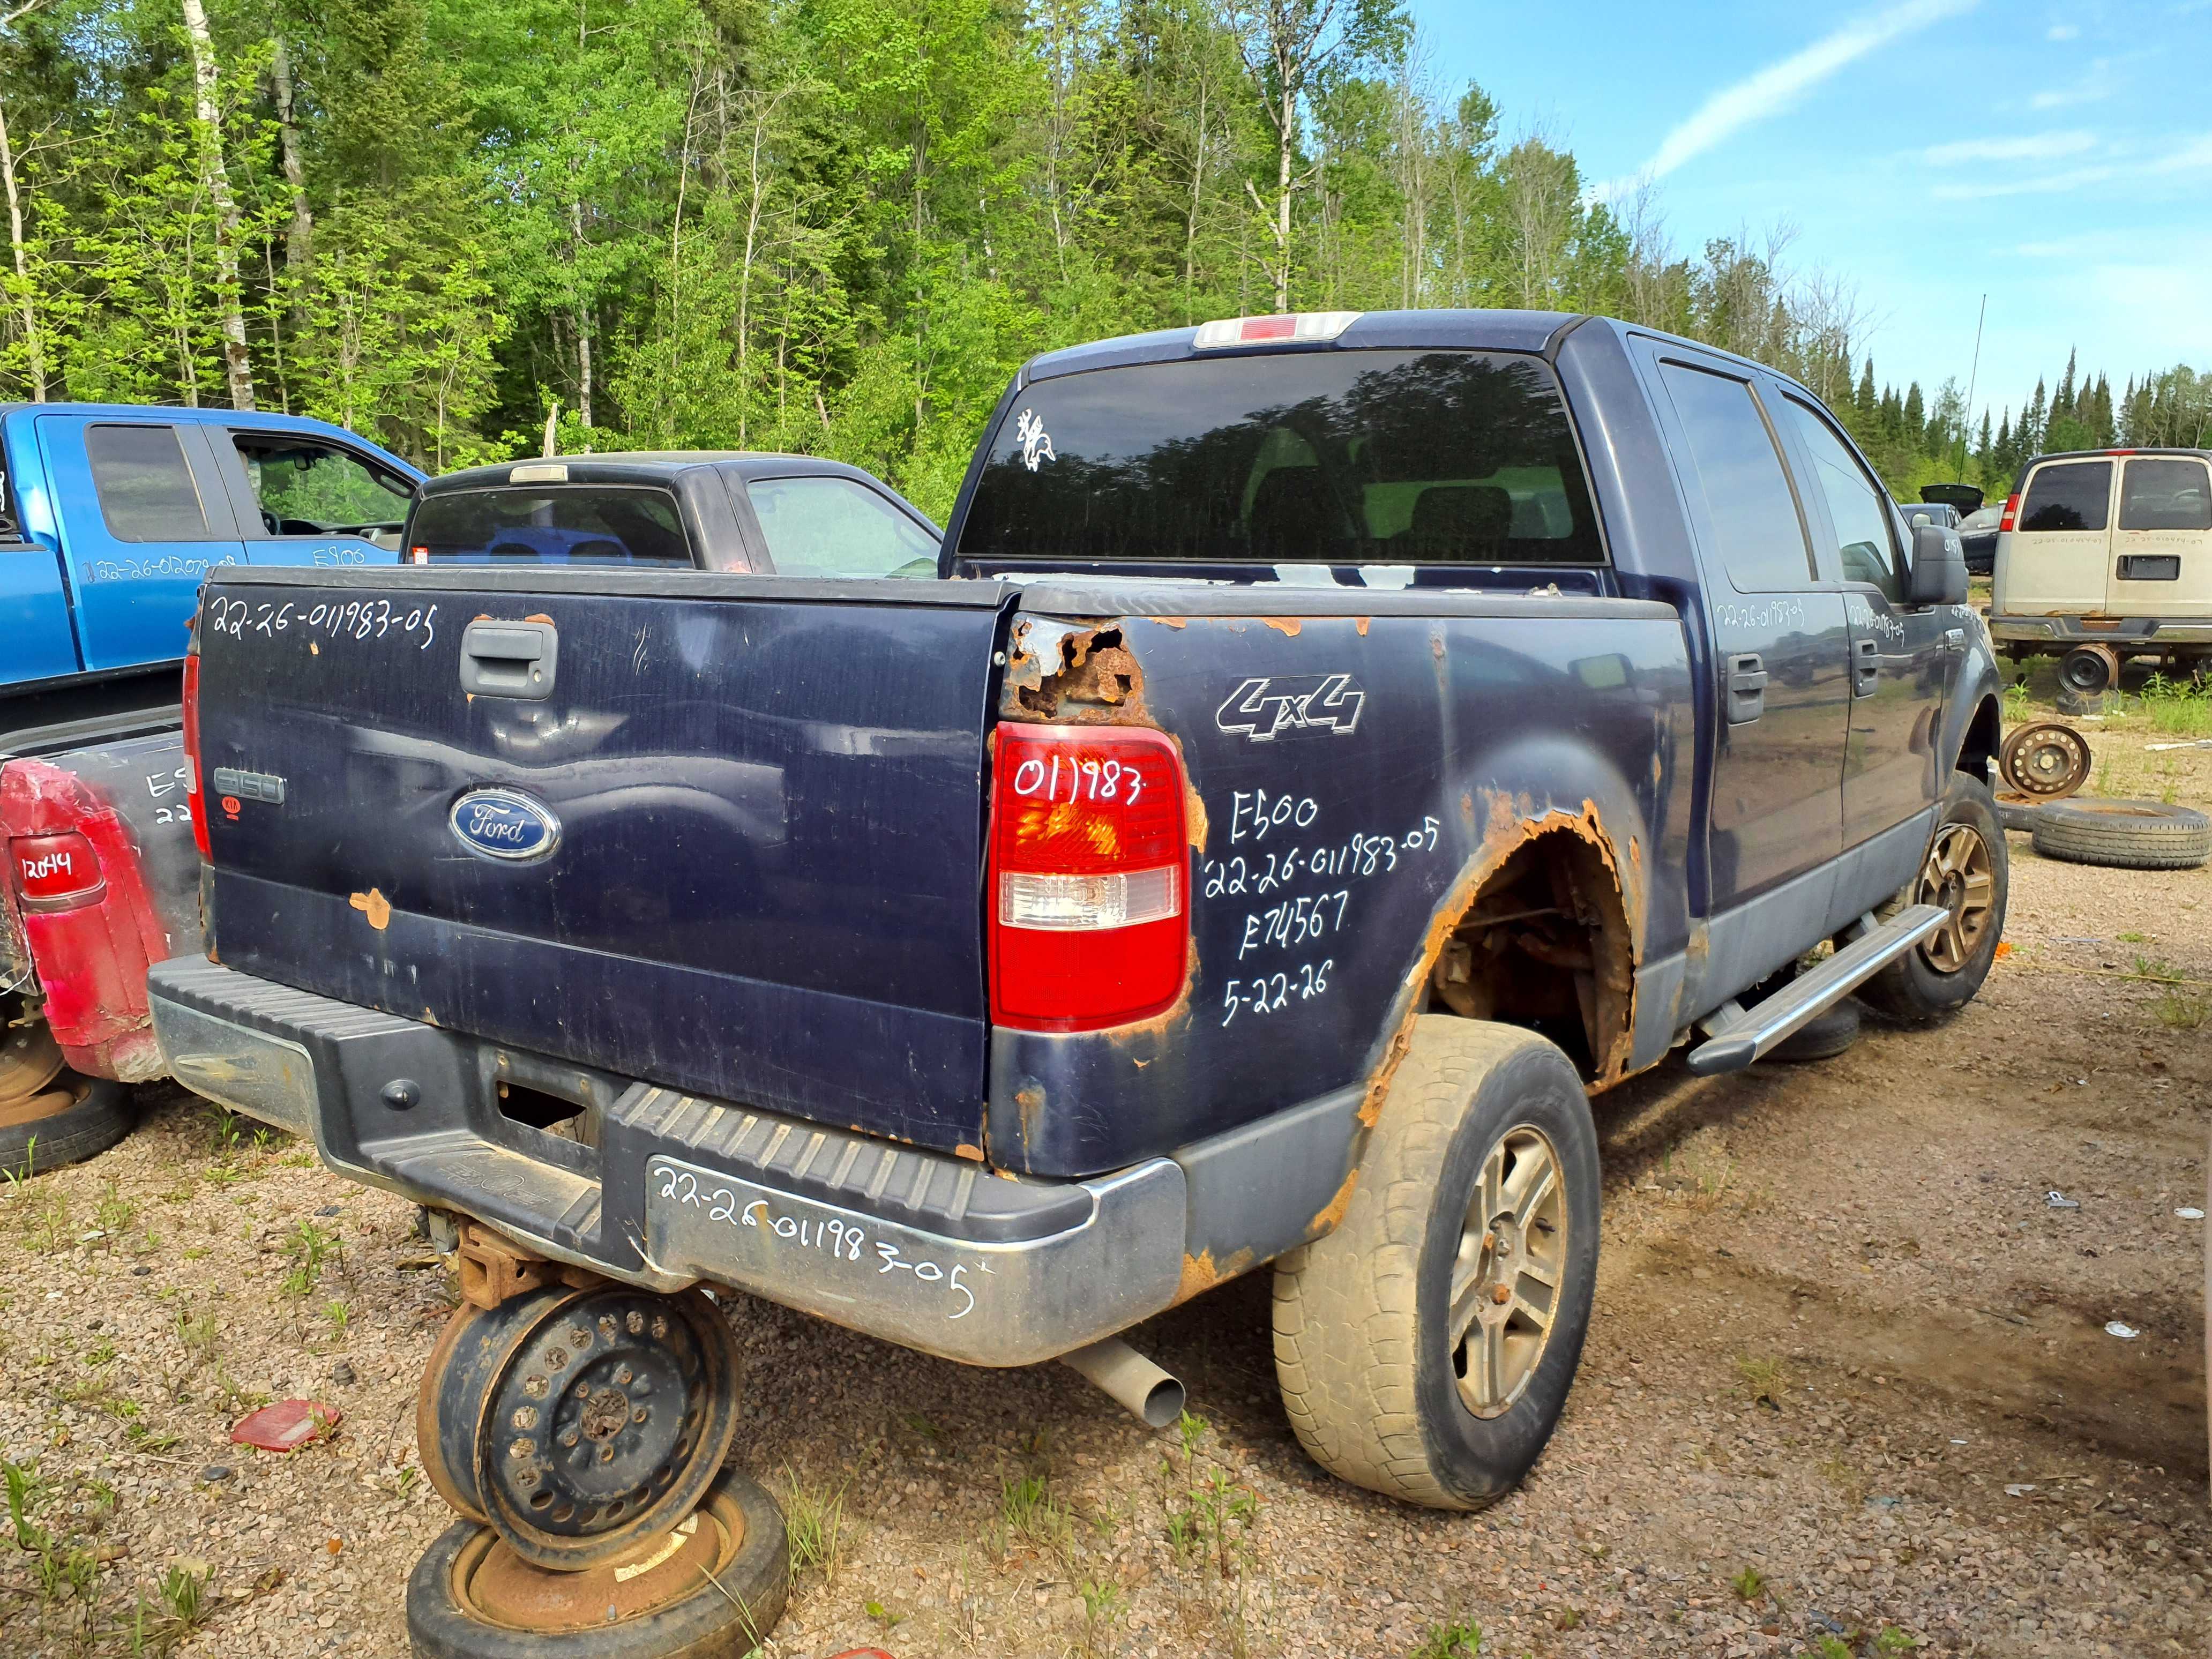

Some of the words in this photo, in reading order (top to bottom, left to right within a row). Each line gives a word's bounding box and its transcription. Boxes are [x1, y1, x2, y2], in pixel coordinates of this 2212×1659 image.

[211, 596, 437, 649] 22-26-011983-05
[1014, 754, 1141, 805] 011983
[470, 804, 526, 843] Ford
[1230, 789, 1318, 845] E500
[1238, 890, 1348, 961] E74567
[1222, 959, 1333, 1027] 5-22-26
